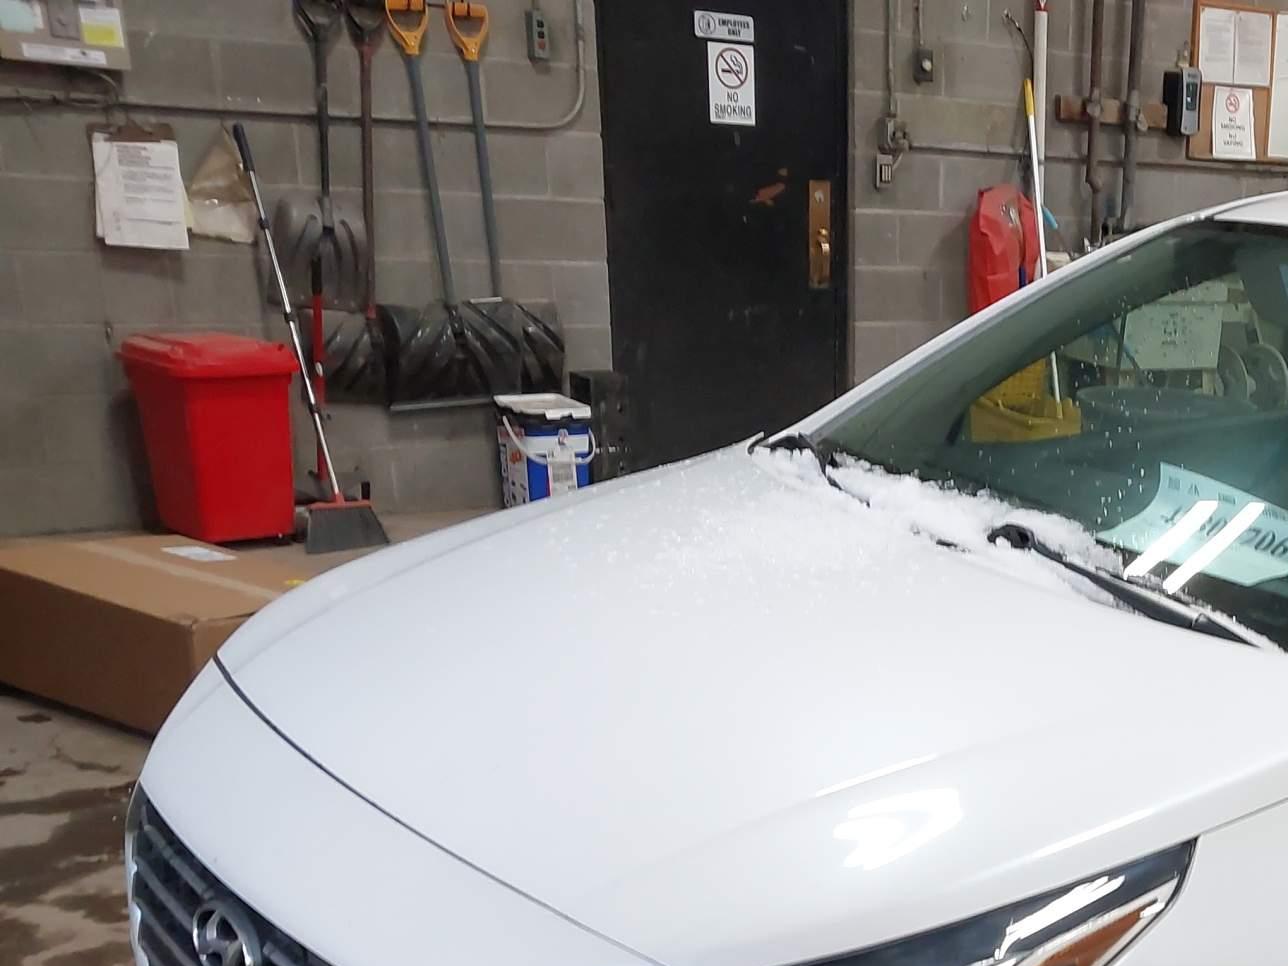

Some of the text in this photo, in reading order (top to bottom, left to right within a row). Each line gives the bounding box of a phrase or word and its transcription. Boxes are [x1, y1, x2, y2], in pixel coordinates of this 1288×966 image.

[727, 28, 741, 37] ONLY
[727, 91, 739, 103] NO
[714, 103, 752, 118] SMOKING
